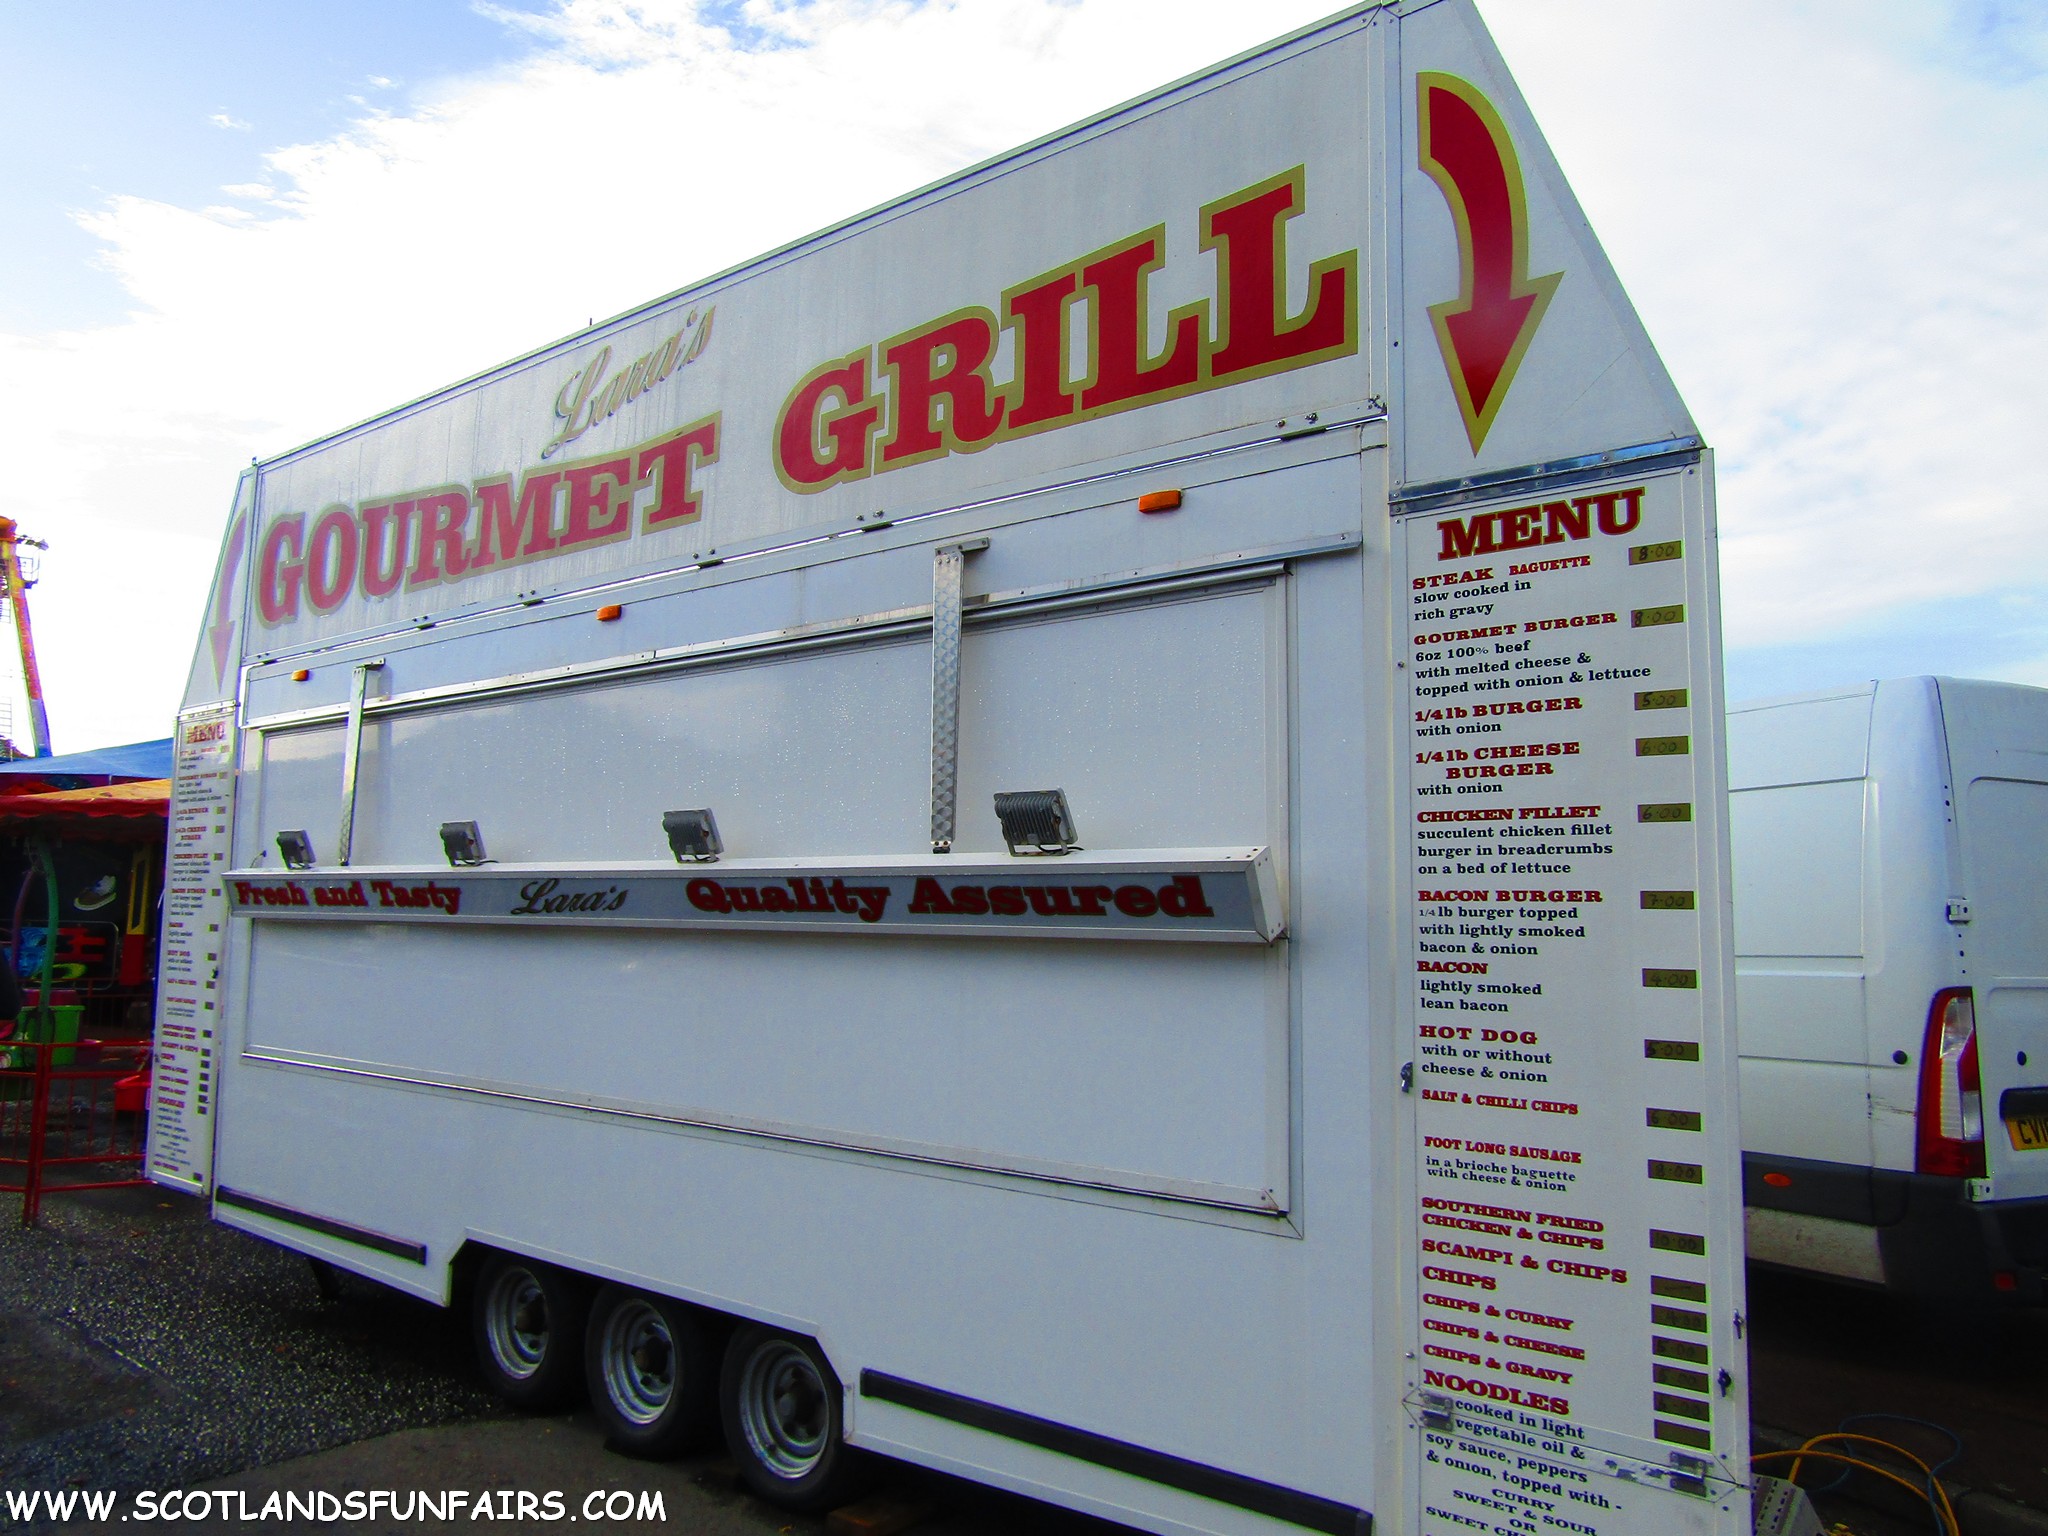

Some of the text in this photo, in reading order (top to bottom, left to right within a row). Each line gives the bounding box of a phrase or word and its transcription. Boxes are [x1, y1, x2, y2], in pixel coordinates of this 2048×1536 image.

[541, 305, 716, 460] Lara's
[256, 163, 1358, 630] GOURMET GRILL
[1437, 486, 1646, 561] MENU
[1412, 555, 1591, 590] STEAK BAGUETTE
[1414, 580, 1532, 604] slow cooked in
[1414, 603, 1494, 621] rich gravy
[1413, 612, 1617, 645] GOURMET BURGER
[1415, 640, 1531, 662] 6oz 100% beef
[1415, 652, 1591, 680] with melted cheese &
[1415, 666, 1651, 697] topped with onion & lettuce
[1472, 697, 1583, 718] BURGER
[1416, 722, 1502, 736] with onion
[1473, 742, 1580, 760] CHEESE
[1446, 762, 1554, 779] BURGER
[1417, 782, 1503, 795] with onion
[1417, 806, 1601, 823] CHICKEN FILLET
[1417, 824, 1613, 839] succulent chicken fillet
[1418, 843, 1613, 860] burger in breadcrumbs
[1418, 862, 1571, 875] on a bed of lettuce
[235, 881, 462, 915] Fresh and Tasty
[511, 878, 630, 915] Lara's
[685, 875, 1214, 923] Quality Assured
[1418, 890, 1603, 902] BACON BURGER
[1458, 907, 1515, 920] burger
[1519, 907, 1578, 921] topped
[1419, 924, 1585, 939] with lightly smoked
[1420, 942, 1538, 955] bacon & onion
[1417, 961, 1488, 974] BACON
[1420, 980, 1542, 995] lightly smoked
[1420, 998, 1508, 1012] lean bacon
[1419, 1025, 1537, 1044] HOT DOG
[1422, 1044, 1552, 1064] with or without
[1422, 1063, 1548, 1083] cheese & onion
[1422, 1089, 1579, 1115] SALT & CHILLI CHIPS
[1424, 1136, 1582, 1163] FOOT LONG SAUSAGE
[1426, 1156, 1576, 1182] in a brioche baguette
[1427, 1168, 1567, 1191] with cheese & onion
[1422, 1197, 1604, 1232] SOUTHERN FRIED
[1422, 1213, 1604, 1250] CHICKEN & CHIPS
[1422, 1239, 1628, 1283] SCAMPI & CHIPS
[1422, 1266, 1497, 1290] CHIPS
[1423, 1293, 1573, 1330] CHIPS & CURRY
[1423, 1319, 1585, 1360] CHIPS & CHEESE
[1423, 1344, 1573, 1384] CHIPS & GRAVY
[1423, 1369, 1569, 1416] NOODLES
[1455, 1400, 1585, 1439] cooked in light
[1456, 1419, 1585, 1459] vegetable oil &
[1426, 1433, 1588, 1483] soy sauce, peppers
[1426, 1450, 1439, 1462] &
[1445, 1456, 1496, 1479] onion,
[1503, 1470, 1562, 1497] topped
[1569, 1489, 1609, 1509] with
[1492, 1487, 1555, 1512] CURRY
[1426, 1506, 1488, 1531] SWEET
[1453, 1489, 1597, 1536] SWEET & SOUR
[1509, 1518, 1537, 1533] OR
